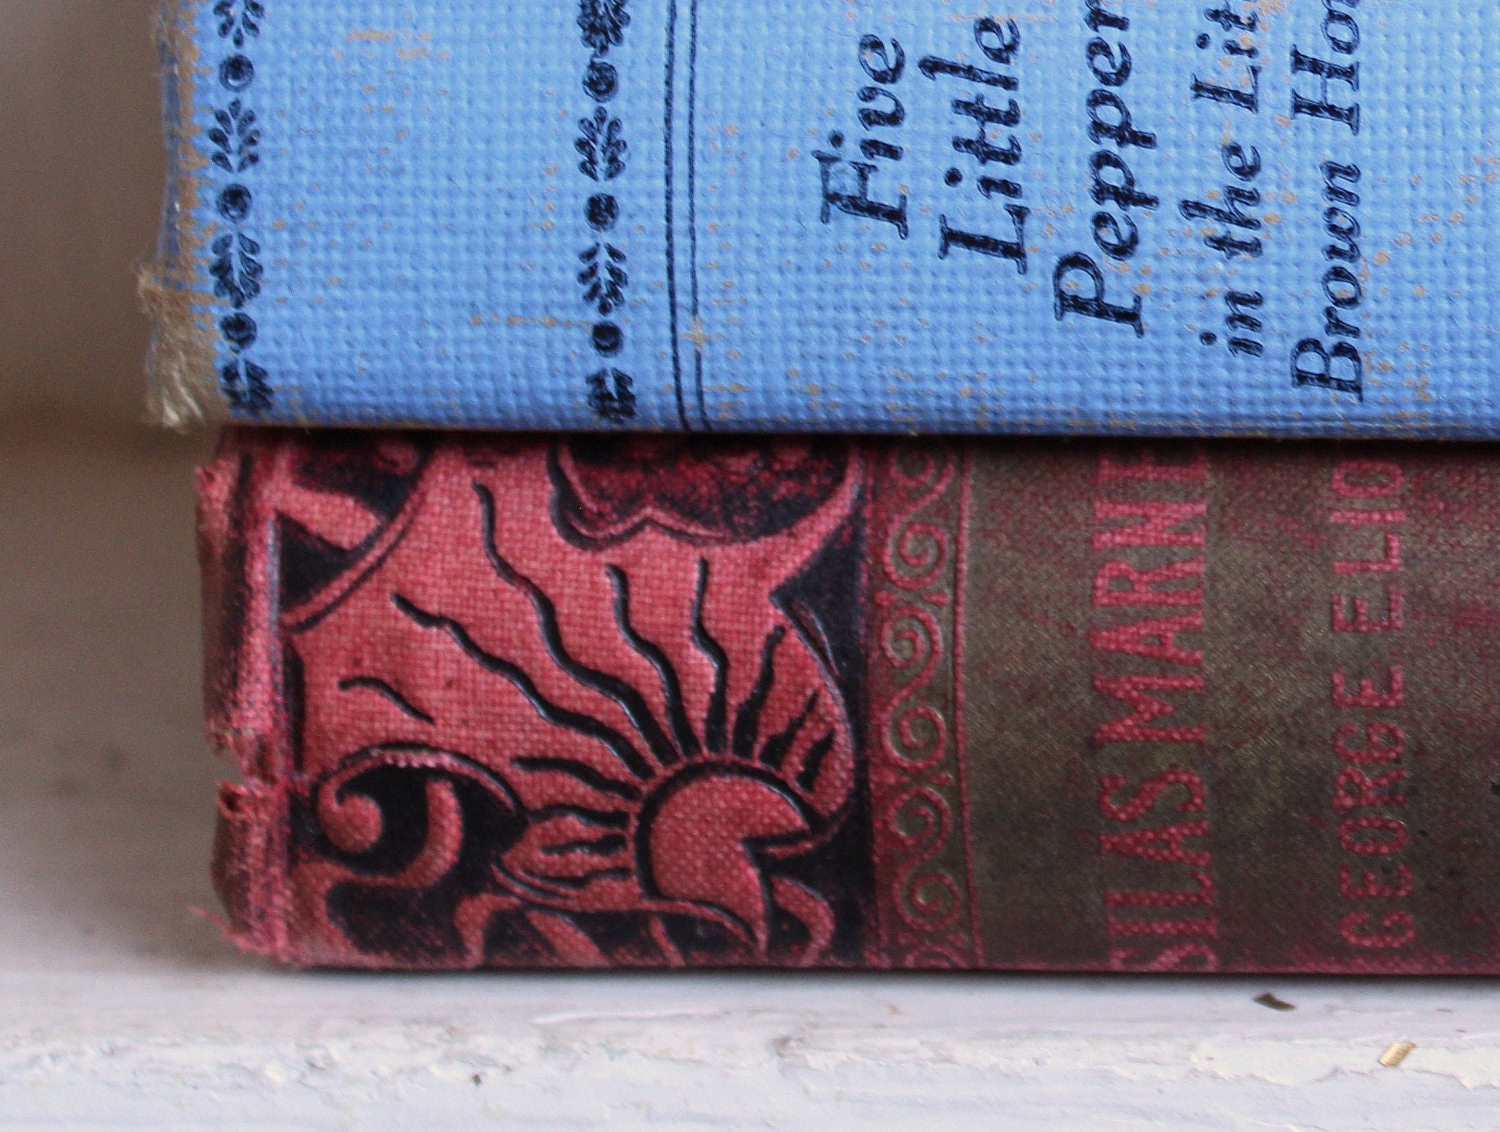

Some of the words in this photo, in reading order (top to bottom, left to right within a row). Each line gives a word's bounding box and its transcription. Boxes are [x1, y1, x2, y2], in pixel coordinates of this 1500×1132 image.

[812, 33, 908, 239] Five
[919, 15, 1028, 274] Little
[1180, 140, 1264, 264] the
[1200, 288, 1265, 358] in
[1290, 160, 1365, 403] Brown
[1099, 771, 1219, 969] SILAS
[1330, 669, 1415, 949] GEORGE
